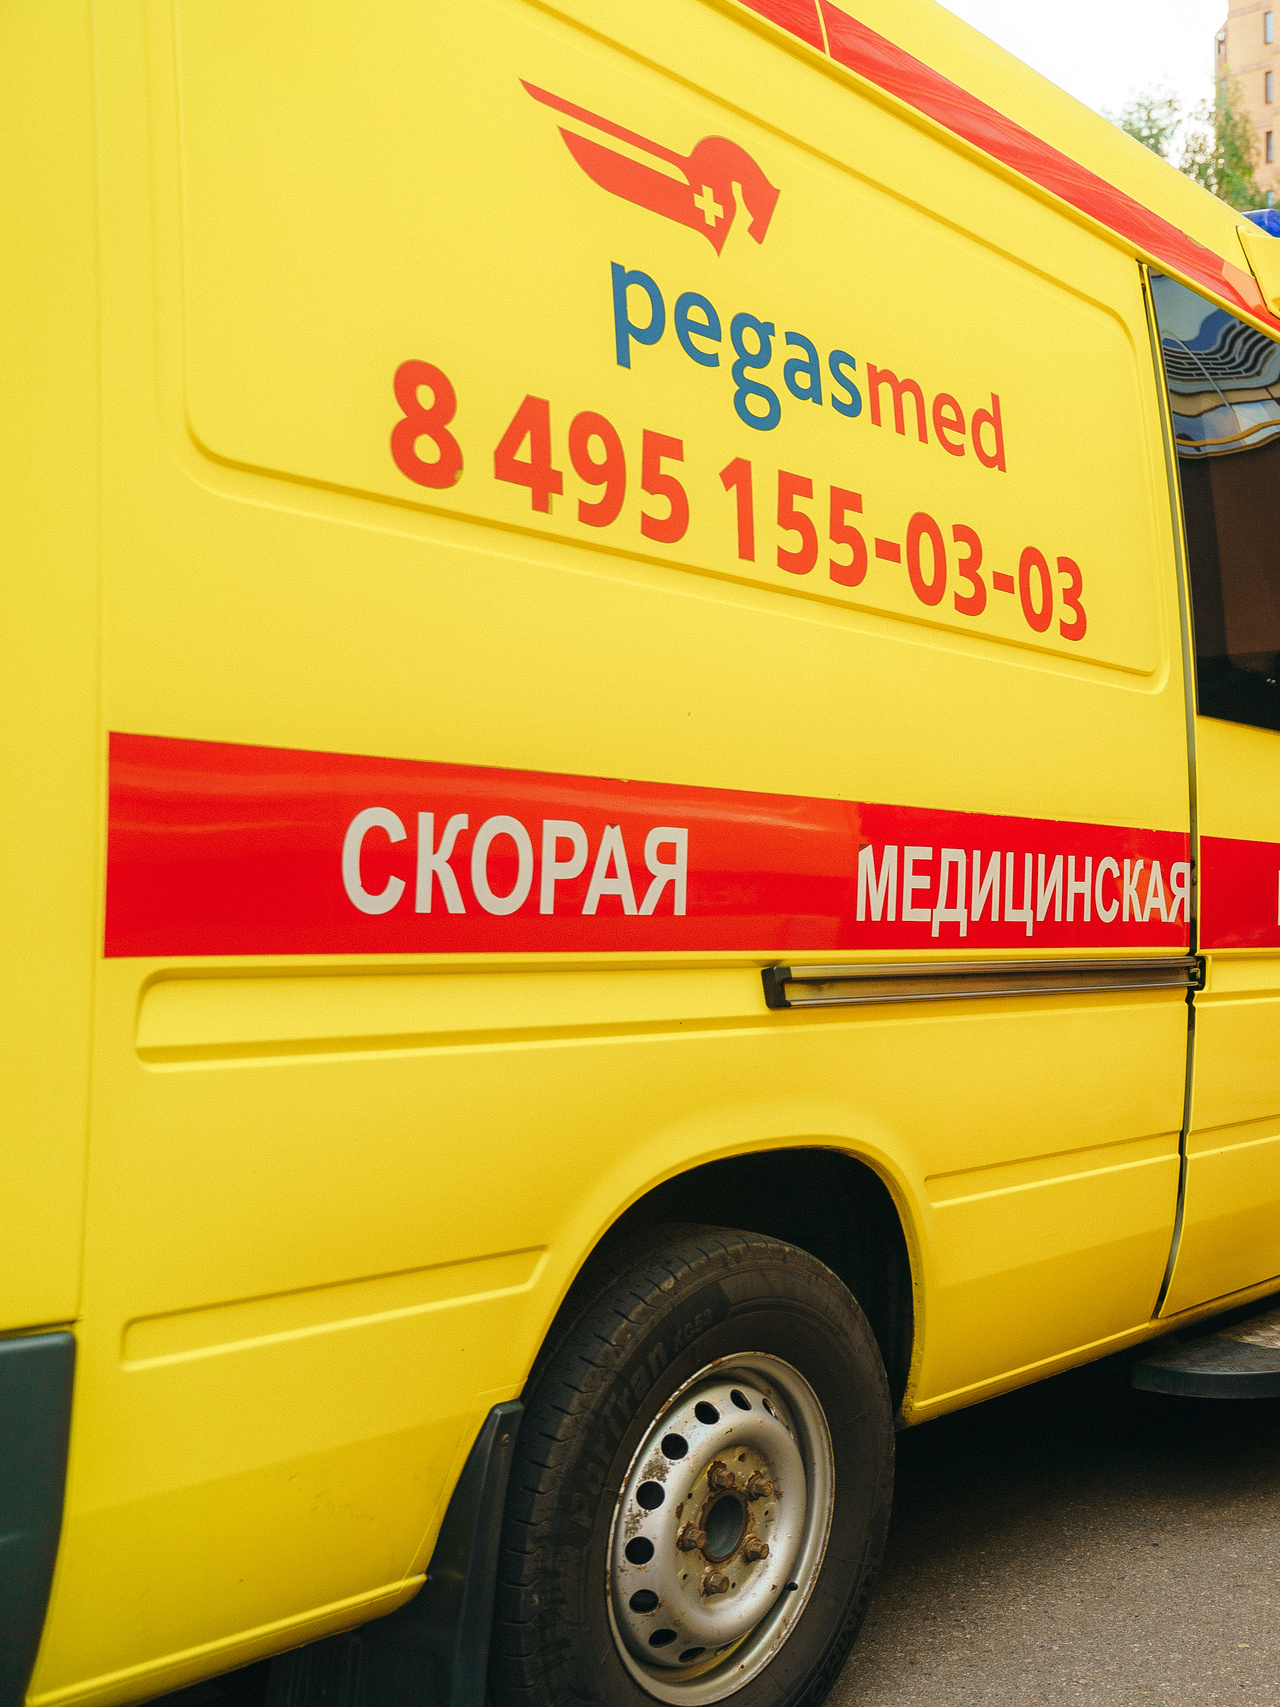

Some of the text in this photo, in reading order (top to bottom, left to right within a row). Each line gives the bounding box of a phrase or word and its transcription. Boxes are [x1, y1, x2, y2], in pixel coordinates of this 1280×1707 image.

[611, 262, 1008, 473] pegasmed
[390, 359, 1088, 642] 8 495 155-03-03
[342, 806, 689, 916] СКОРАЯ
[855, 844, 1191, 938] МЕДИЦИНСКАЯ
